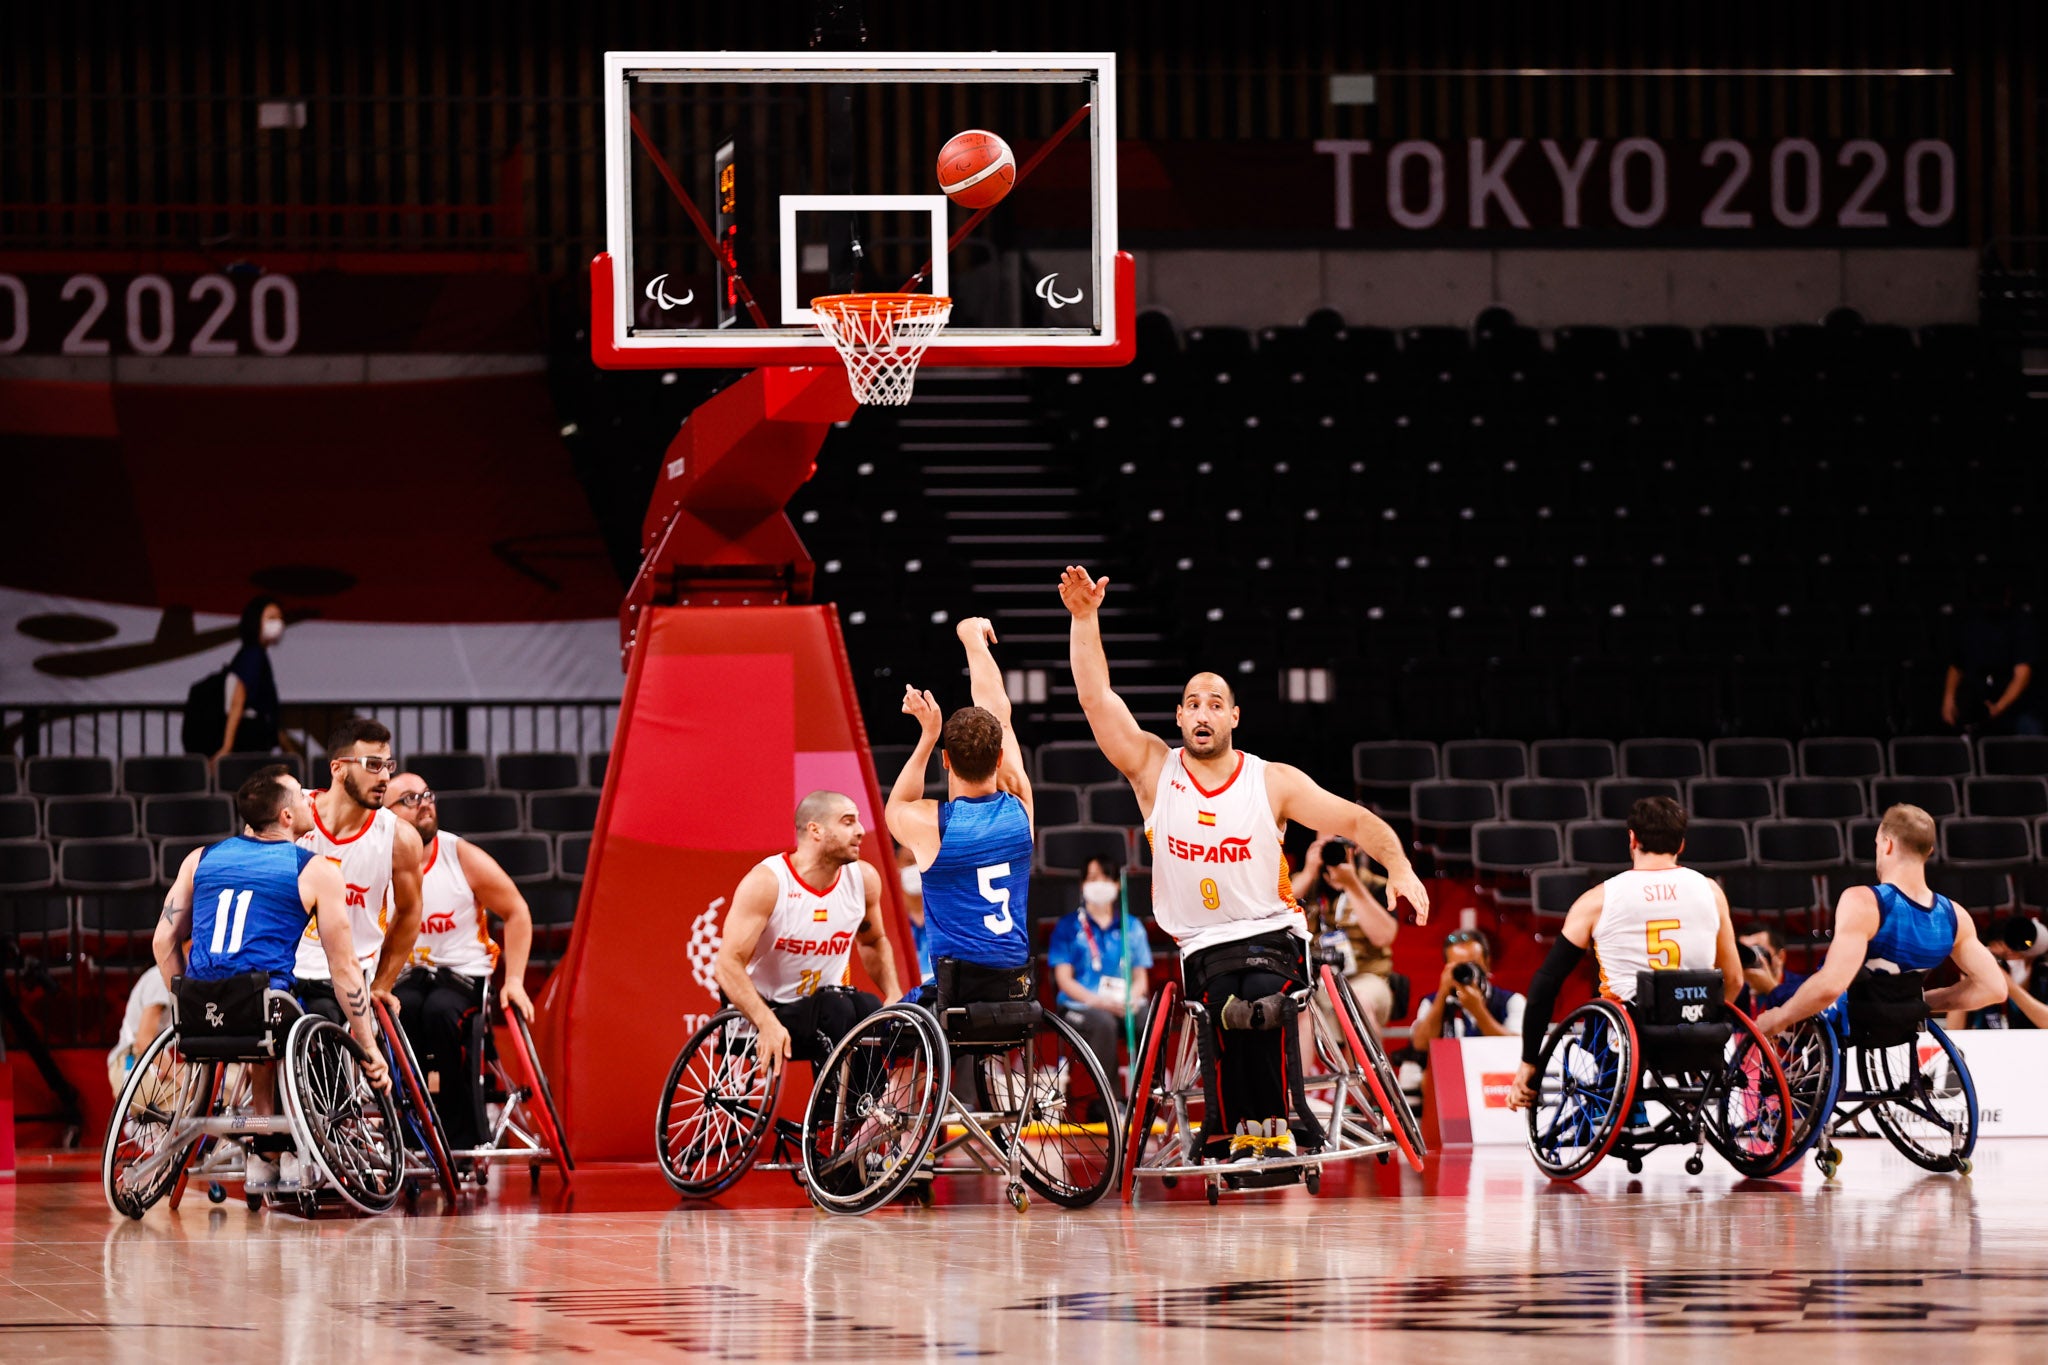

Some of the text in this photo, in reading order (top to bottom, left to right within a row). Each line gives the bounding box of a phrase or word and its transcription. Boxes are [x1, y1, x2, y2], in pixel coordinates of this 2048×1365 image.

[1314, 138, 1956, 230] TOKYO 2020
[60, 273, 300, 357] 2020
[1167, 835, 1253, 864] ESPAÑA
[976, 862, 1014, 936] 5
[1200, 877, 1220, 910] 9
[1643, 883, 1678, 902] STIX
[209, 888, 254, 954] 11
[1645, 918, 1682, 971] 5
[1674, 986, 1708, 1001] STIX
